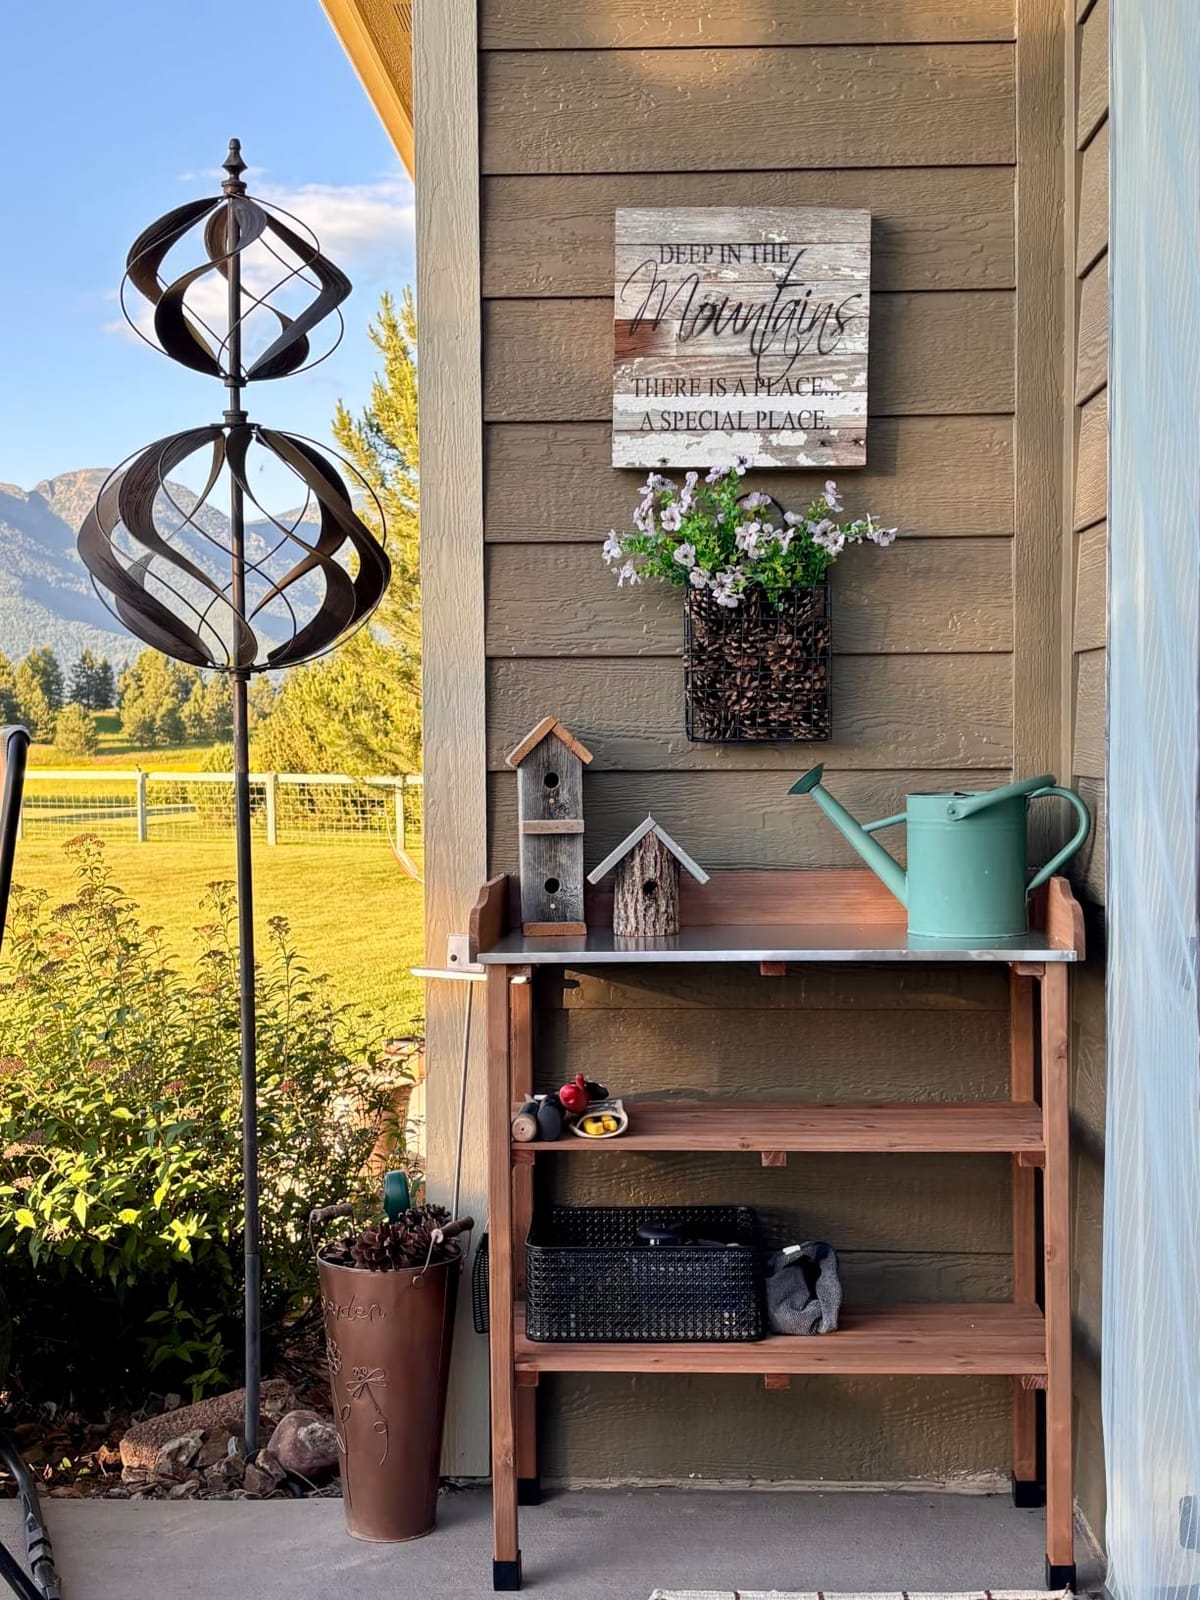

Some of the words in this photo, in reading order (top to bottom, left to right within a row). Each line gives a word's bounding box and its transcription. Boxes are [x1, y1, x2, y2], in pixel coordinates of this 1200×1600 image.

[659, 244, 713, 264] DEEP
[720, 244, 741, 264] IN
[750, 243, 790, 263] THE
[620, 248, 862, 388] Mountains
[631, 378, 700, 397] THERE
[709, 378, 727, 397] IS
[732, 378, 748, 397] A
[640, 411, 655, 431] A
[660, 411, 750, 430] SPECIAL
[756, 410, 830, 430] PLACE.
